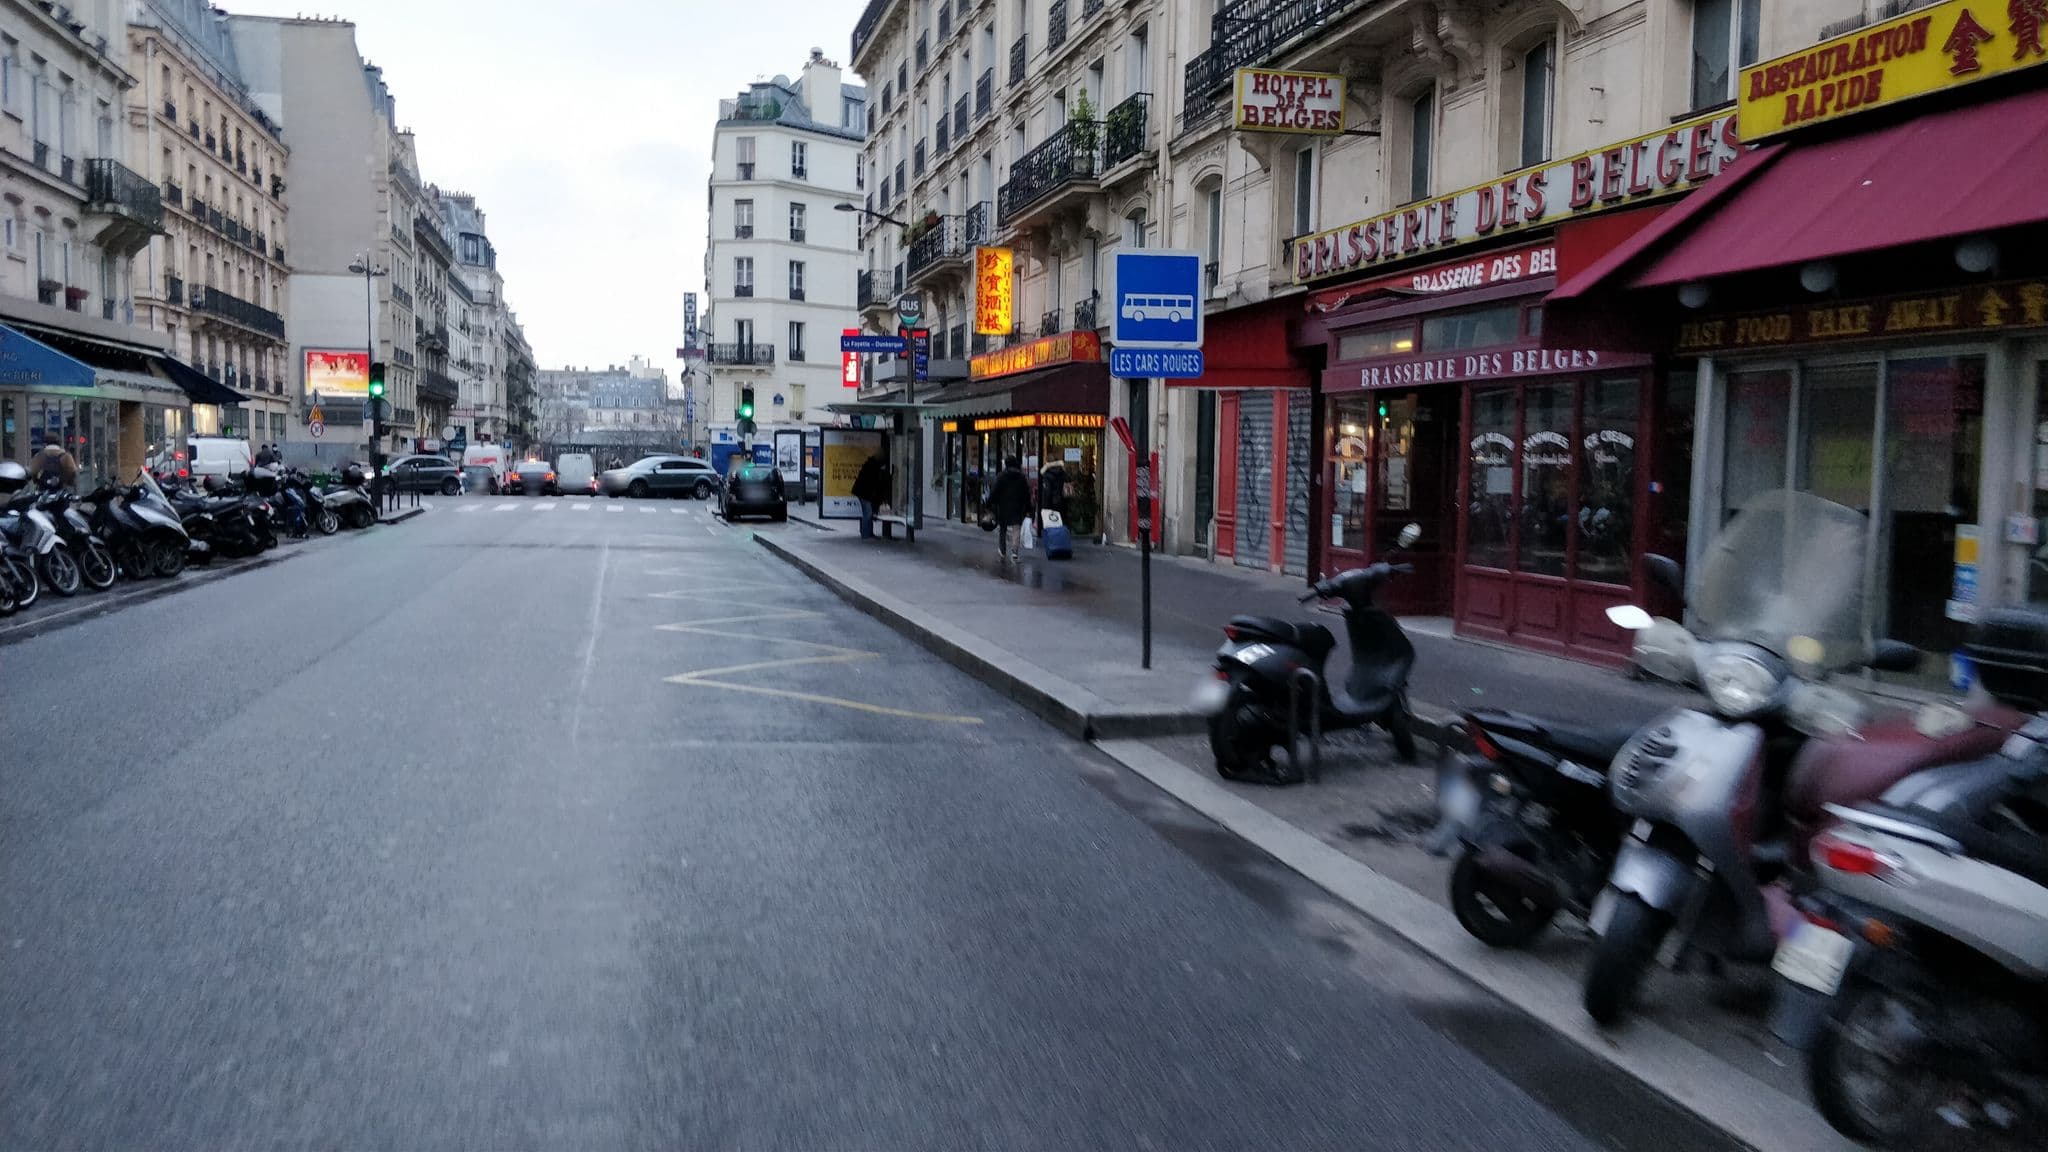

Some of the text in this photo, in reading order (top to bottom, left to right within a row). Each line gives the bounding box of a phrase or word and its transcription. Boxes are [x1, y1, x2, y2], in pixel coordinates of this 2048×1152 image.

[1748, 15, 1933, 103] RESTAURATION
[1252, 72, 1332, 99] HOTEL
[1782, 68, 1884, 126] RAPIDE
[1276, 91, 1306, 109] DES
[1242, 104, 1342, 131] BELGES
[1296, 114, 1745, 280] BRASSERIE DES BELGES
[1412, 262, 1485, 292] BRASSERIE
[1490, 254, 1522, 282] DES
[976, 248, 984, 331] RESTAURANT
[900, 300, 919, 311] BUS
[1679, 296, 1963, 348] FAST FOOD TAKE AWAY
[843, 340, 850, 348] La
[851, 340, 870, 349] Fayette
[875, 340, 903, 349] Dunkerque
[1114, 353, 1200, 373] LES CARS ROUGES
[1360, 349, 1599, 387] BRASSERIE DES BELGES
[1040, 414, 1101, 427] RESTAURANT
[1048, 432, 1096, 447] TRAITEUR
